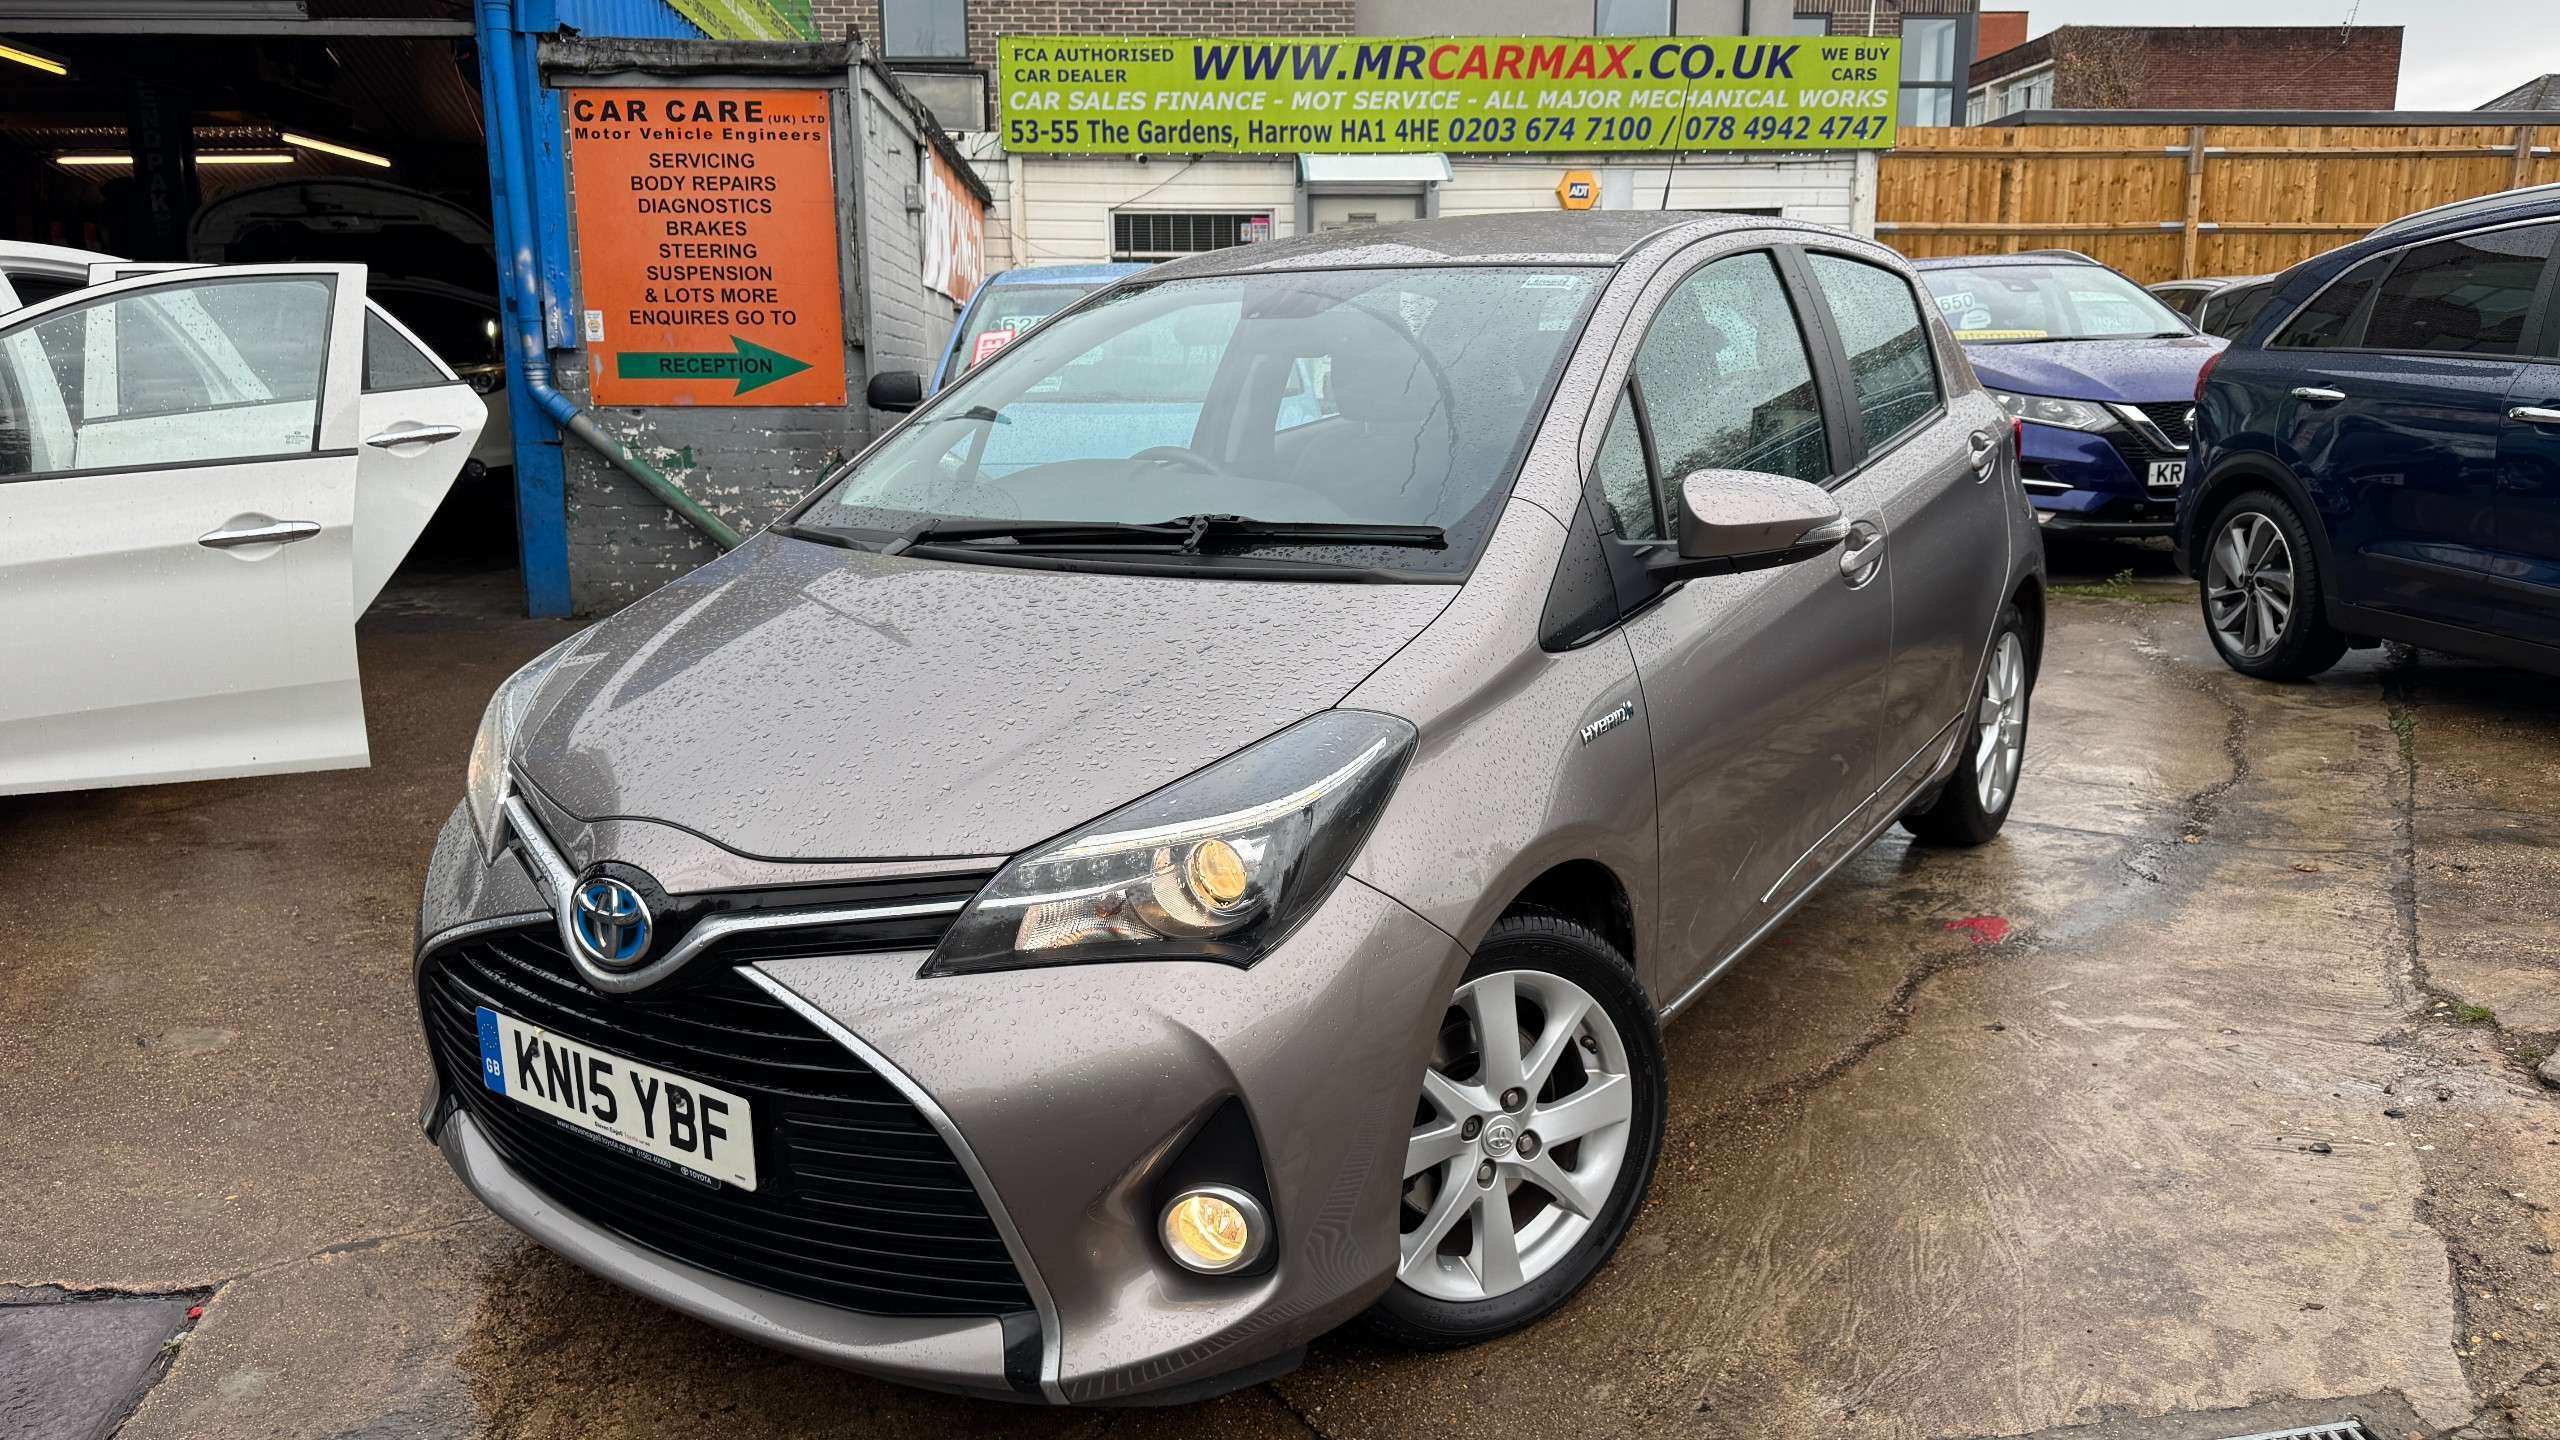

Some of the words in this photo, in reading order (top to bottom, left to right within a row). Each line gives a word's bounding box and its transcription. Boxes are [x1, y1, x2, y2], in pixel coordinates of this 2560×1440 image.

[1014, 48, 1048, 62] FCA
[1054, 48, 1174, 62] AUTHORISED
[1193, 44, 1801, 81] WWW.MRCARMAX.CO.UK
[1821, 48, 1850, 61] WE
[1854, 47, 1890, 61] BUY
[1014, 69, 1051, 83] CAR
[1058, 69, 1127, 83] DEALER
[1831, 67, 1878, 81] CARS
[1010, 91, 1066, 111] CAR
[1068, 91, 1146, 111] SALES
[1154, 91, 1265, 111] FINANCE
[1291, 91, 1347, 110] MOT
[1353, 91, 1460, 110] SERVICE
[1484, 91, 1529, 109] ALL
[1536, 90, 1623, 110] MAJOR
[1628, 89, 1789, 109] MECHANICAL
[1798, 89, 1889, 108] WORKS
[573, 100, 648, 123] CAR
[665, 99, 764, 123] CARE
[768, 114, 796, 125] (UK)
[801, 114, 826, 125] LTD
[574, 128, 631, 141] Motor
[640, 127, 714, 141] Vehicle
[722, 128, 822, 144] Engineers
[1010, 119, 1079, 144] 53-55
[1087, 119, 1129, 144] The
[1137, 118, 1239, 148] Gardens,
[1248, 119, 1332, 144] Harrow
[1341, 118, 1386, 143] HA1
[1395, 118, 1440, 143] 4HE
[1448, 117, 1516, 143] 0203
[1525, 117, 1575, 142] 674
[1585, 116, 1653, 141] 7100
[1685, 116, 1735, 141] 078
[1743, 115, 1811, 140] 4942
[1818, 115, 1888, 140] 4747
[649, 152, 755, 170] SERVICING
[631, 175, 686, 192] BODY
[692, 175, 777, 192] REPAIRS
[1568, 184, 1590, 198] ADT
[638, 198, 773, 215] DIAGNOSTICS
[666, 220, 747, 237] BRAKES
[659, 243, 758, 260] STEERING
[647, 265, 773, 282] SUSPENSION
[645, 288, 658, 304] &
[664, 288, 715, 304] LOTS
[721, 287, 778, 304] MORE
[629, 310, 729, 327] ENQUIRES
[735, 310, 765, 326] GO
[769, 310, 797, 326] TO
[659, 357, 774, 374] RECEPTION
[1580, 707, 1626, 744] HYBRID
[486, 1057, 501, 1077] GB
[513, 1029, 618, 1125] KN15
[630, 1069, 729, 1161] YBF
[689, 1169, 712, 1185] TOYOTA
